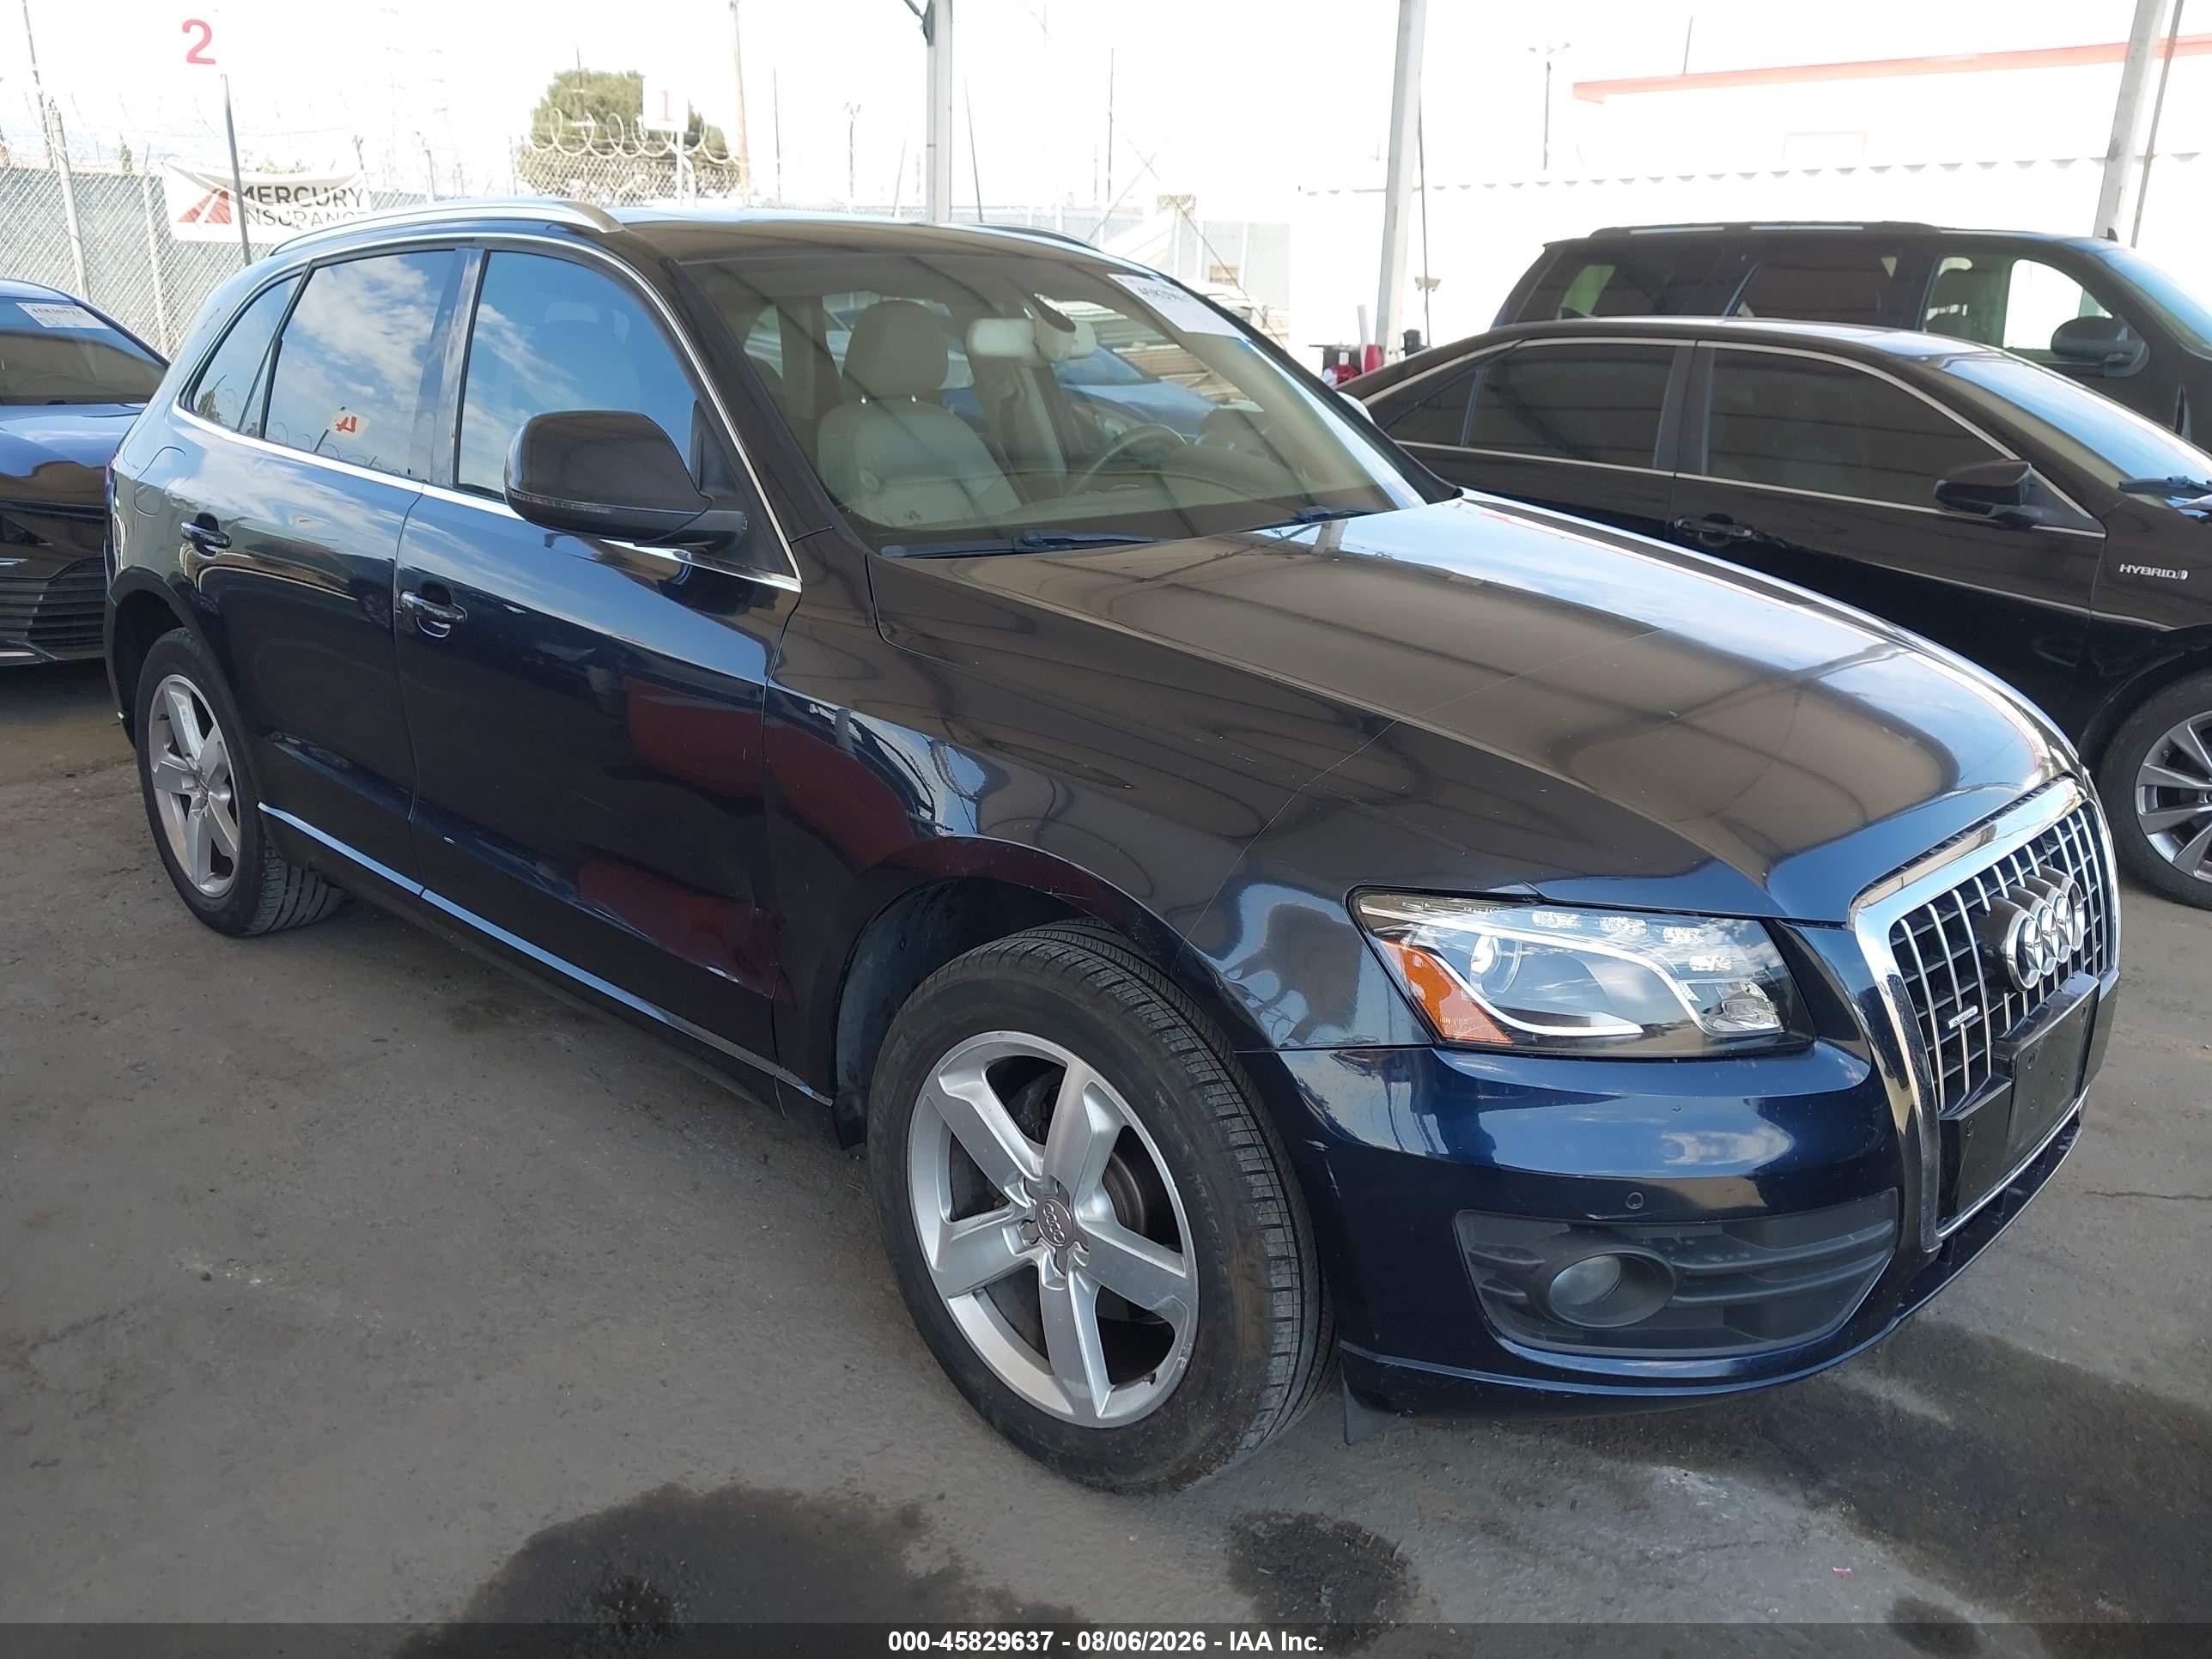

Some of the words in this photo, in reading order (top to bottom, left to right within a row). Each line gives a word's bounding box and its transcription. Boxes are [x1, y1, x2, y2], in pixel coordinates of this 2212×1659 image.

[182, 19, 216, 65] 2
[243, 185, 363, 208] MERCURY
[246, 207, 368, 228] NSURANC
[2118, 563, 2179, 580] HYBRID
